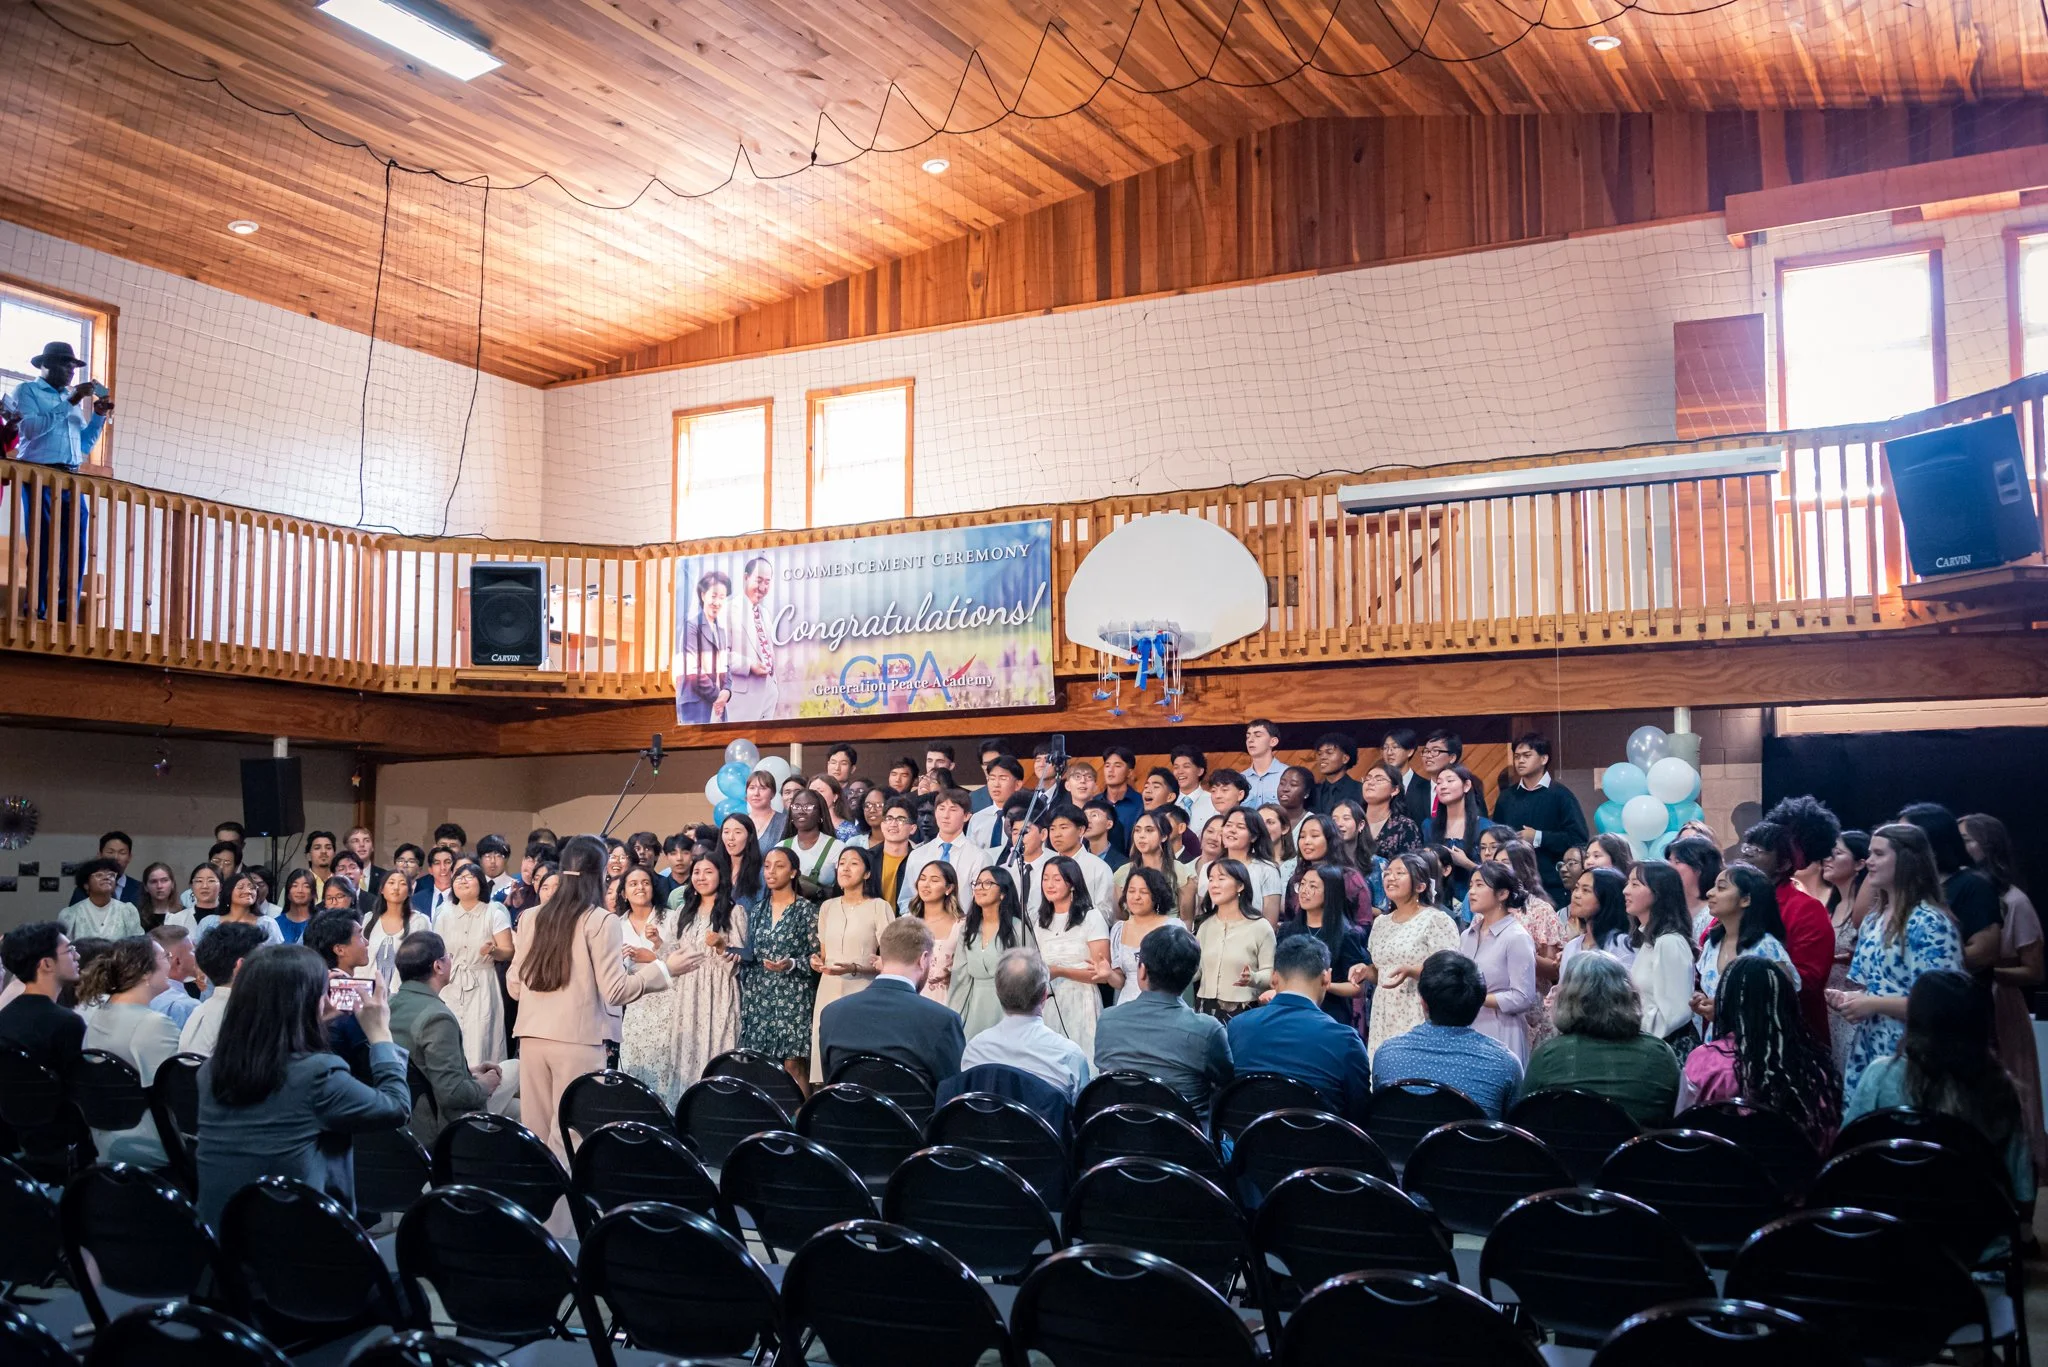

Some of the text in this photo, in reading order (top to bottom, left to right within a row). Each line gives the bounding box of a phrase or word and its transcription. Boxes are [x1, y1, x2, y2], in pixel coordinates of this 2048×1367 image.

[783, 543, 1030, 581] COMMENCEMENT CEREMONY
[1935, 554, 1971, 568] CARVIN
[771, 581, 1047, 652] Congratulations!
[491, 653, 520, 662] CARVIN
[814, 674, 995, 697] Generation Peace Academy
[840, 650, 953, 708] GPA
